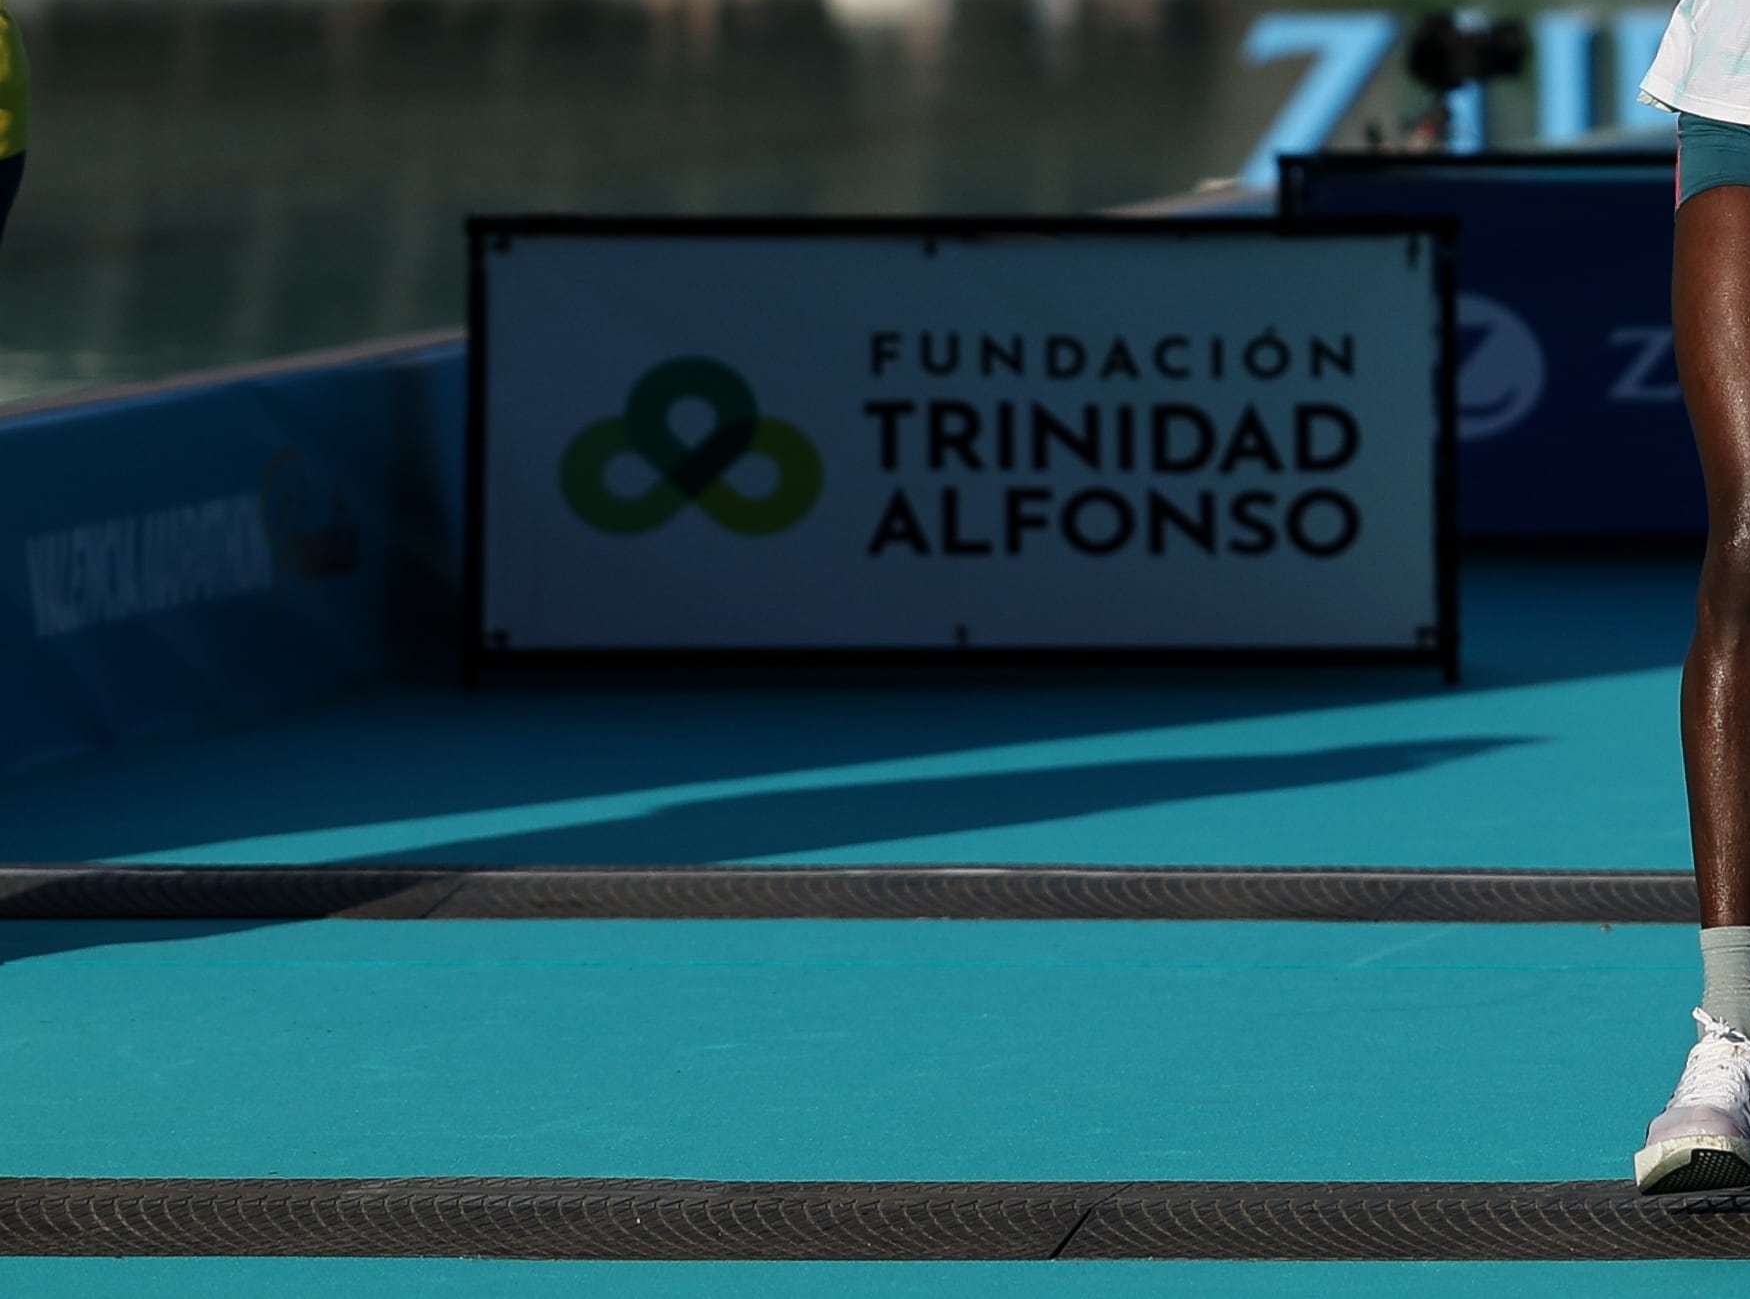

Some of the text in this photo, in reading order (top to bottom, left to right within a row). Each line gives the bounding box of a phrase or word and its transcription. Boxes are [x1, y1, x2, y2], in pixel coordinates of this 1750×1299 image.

[869, 324, 1357, 382] FUNDACIÓN
[863, 400, 1362, 476] TRINIDAD
[866, 486, 1362, 560] ALFONSO
